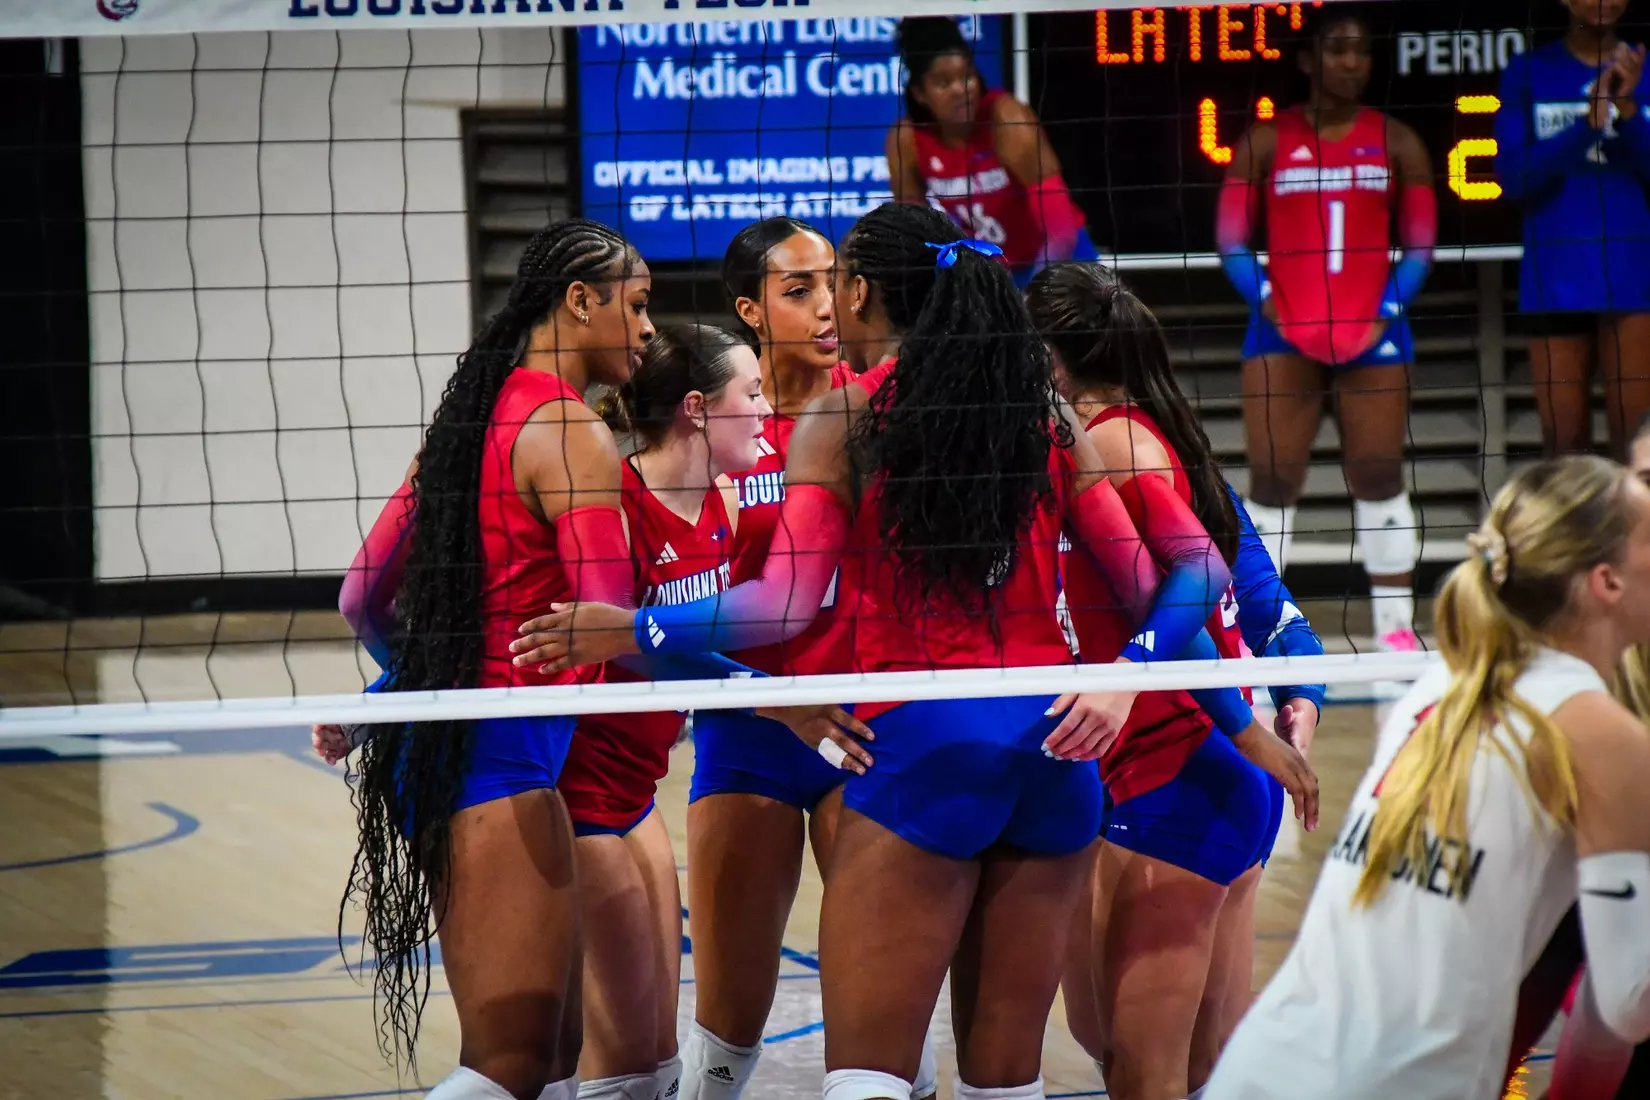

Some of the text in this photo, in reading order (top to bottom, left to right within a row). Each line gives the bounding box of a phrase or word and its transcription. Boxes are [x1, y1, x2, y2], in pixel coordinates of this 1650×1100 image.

[632, 51, 797, 99] Medical
[593, 160, 723, 187] OFFICIAL
[727, 158, 849, 184] IMAGING
[630, 195, 668, 221] OF
[672, 193, 786, 220] LATECH
[1328, 200, 1345, 275] 1
[707, 1068, 734, 1082] adidas
